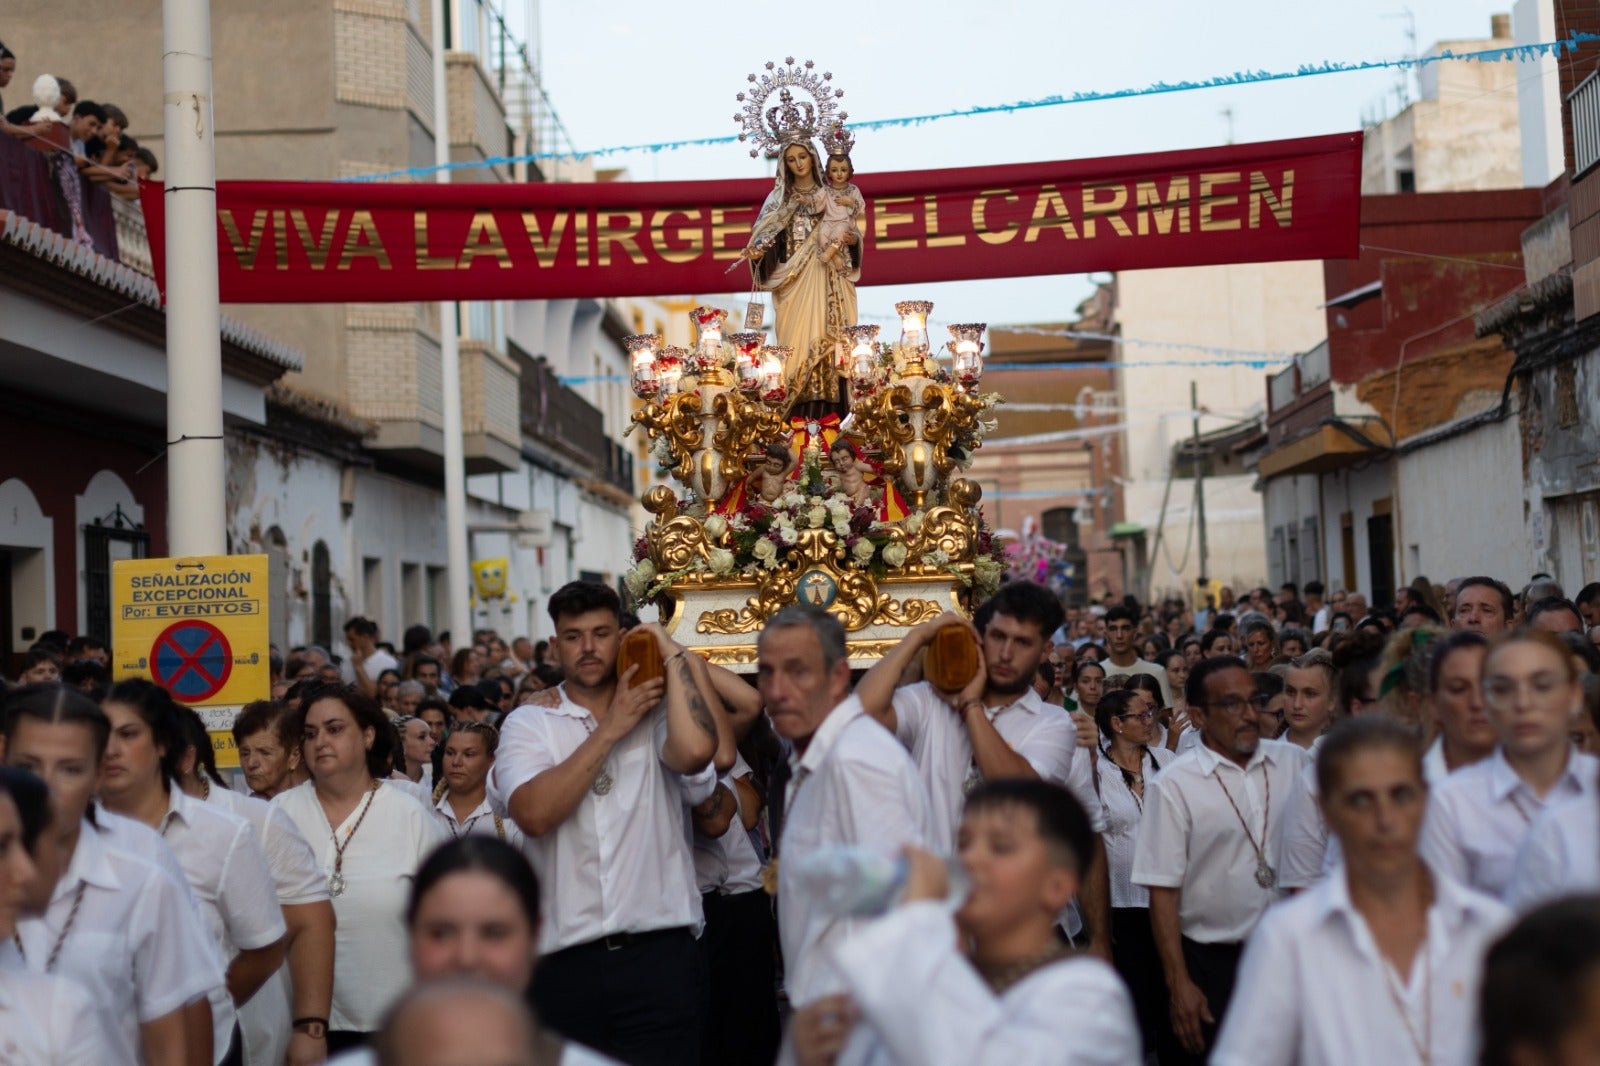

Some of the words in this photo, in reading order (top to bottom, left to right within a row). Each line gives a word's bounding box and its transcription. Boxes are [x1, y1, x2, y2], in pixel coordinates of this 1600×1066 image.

[218, 209, 392, 270] VIVA
[413, 210, 514, 269] LA
[521, 205, 754, 268] VIRGE
[857, 193, 967, 250] EL
[971, 168, 1296, 244] CARMEN
[131, 570, 252, 588] SEÑALIZACIÓN
[133, 587, 248, 603] EXCEPCIONAL
[124, 606, 151, 618] Por:
[155, 602, 253, 616] EVENTOS
